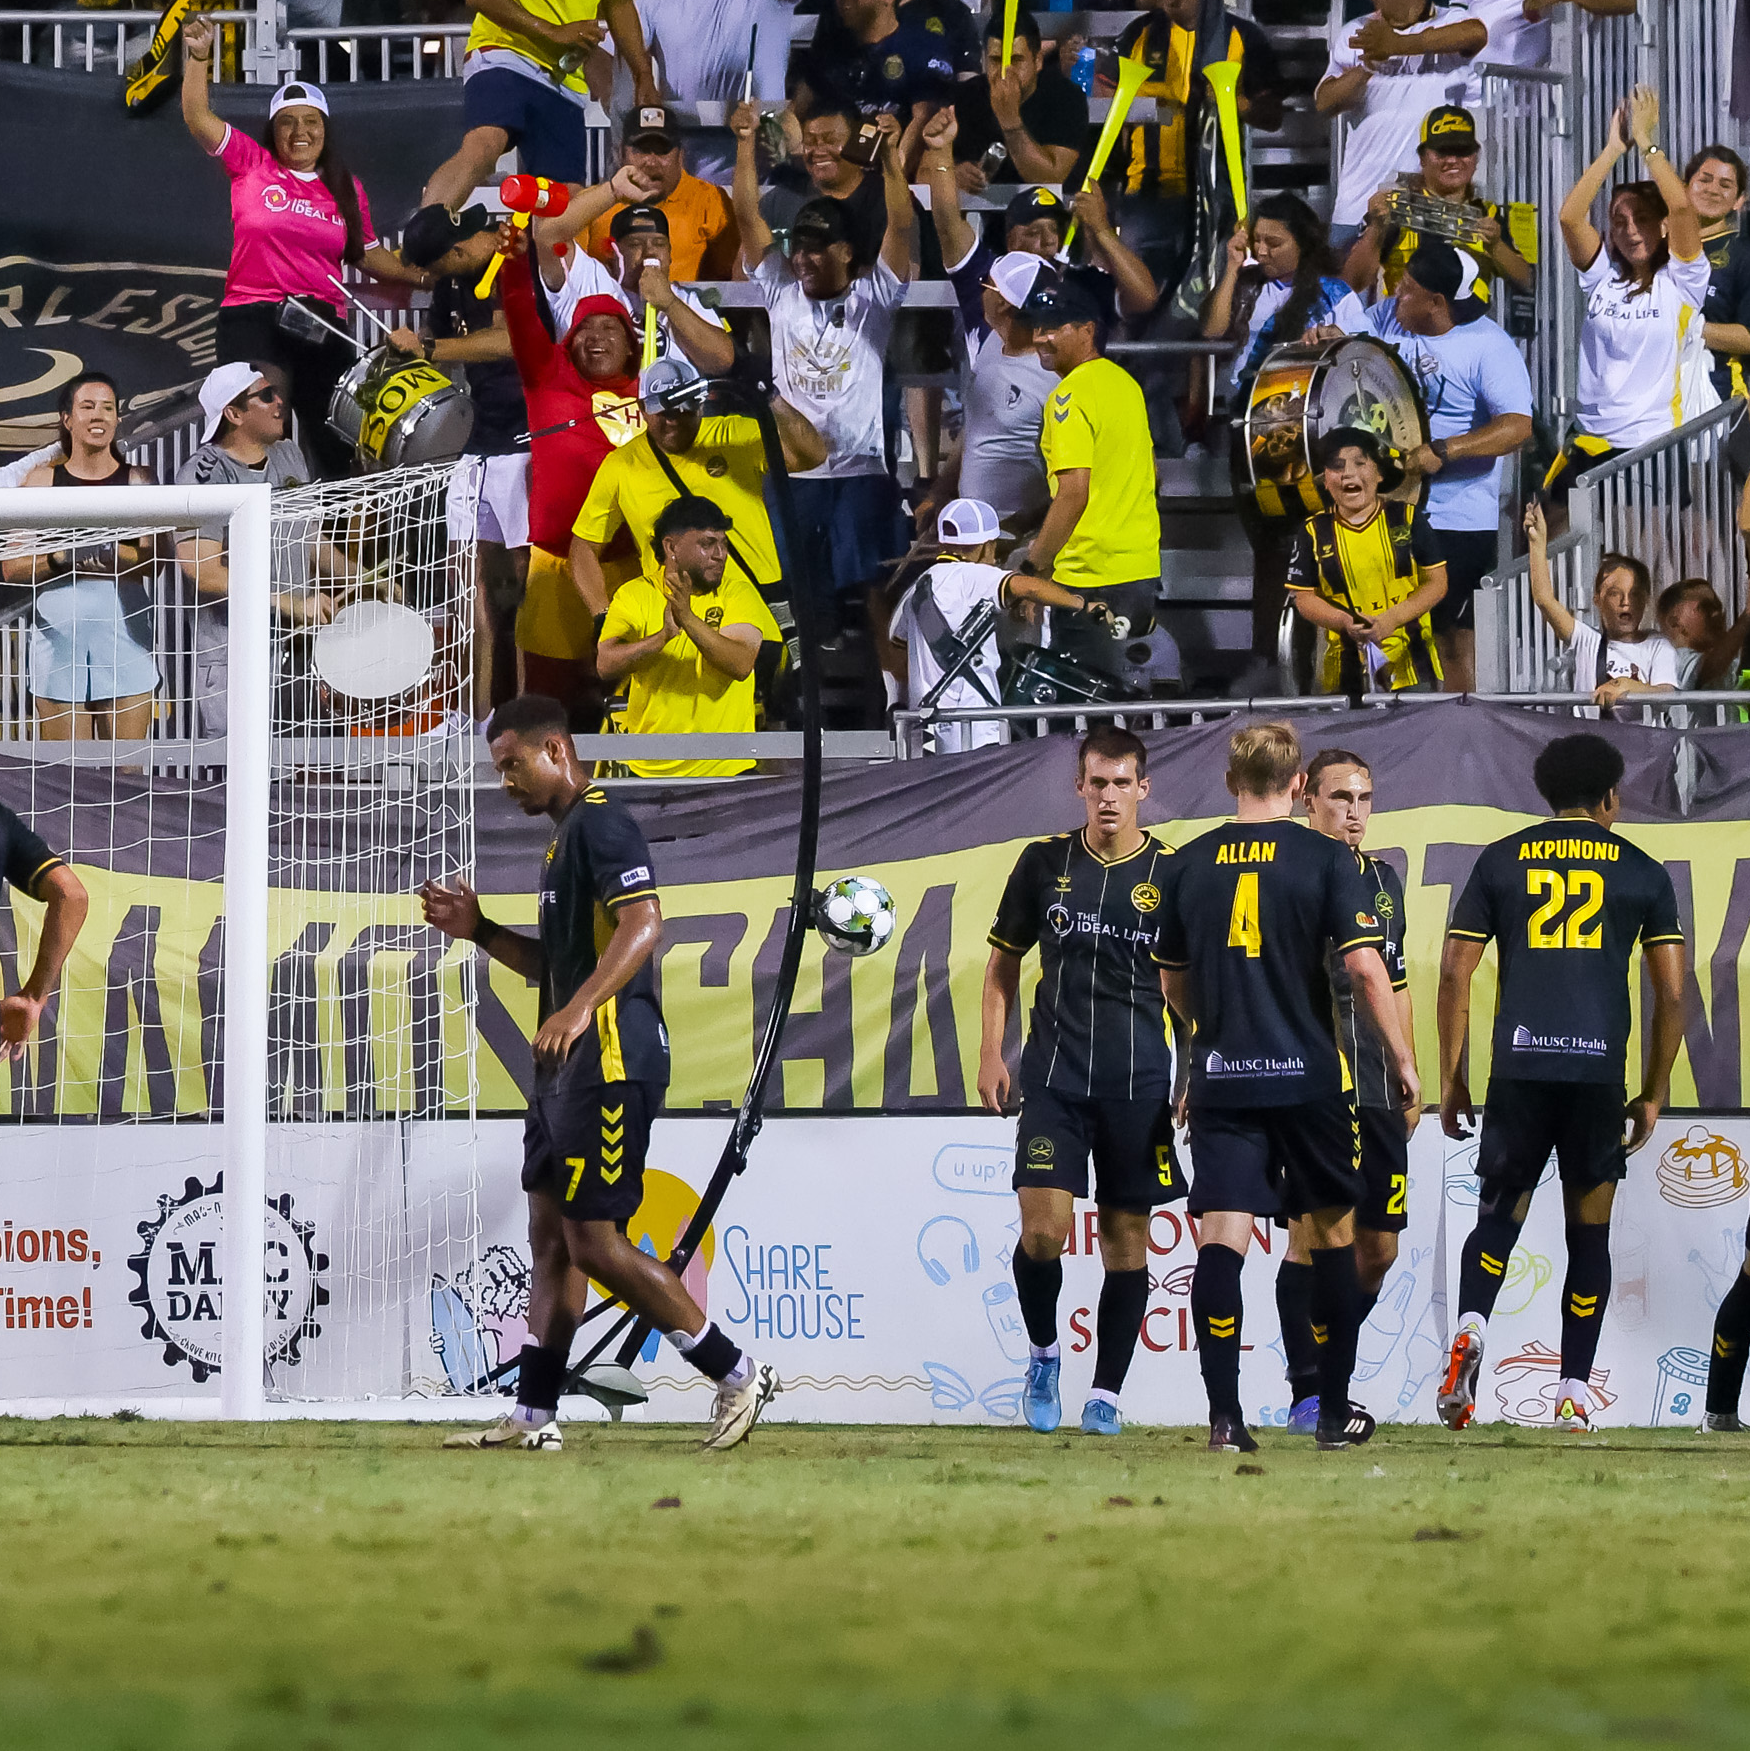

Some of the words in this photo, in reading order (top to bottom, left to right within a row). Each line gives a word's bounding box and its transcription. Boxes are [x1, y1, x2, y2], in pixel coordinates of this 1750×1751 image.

[1215, 842, 1276, 864] ALLAN
[1518, 839, 1620, 862] AKPUNONU
[1077, 912, 1097, 922] THE
[1228, 872, 1262, 957] 4
[1527, 869, 1603, 949] 22
[1077, 923, 1119, 937] IDEAL
[1124, 928, 1153, 944] LIFE
[1531, 1036, 1570, 1047] MUSC
[1572, 1037, 1608, 1051] Health
[1223, 1060, 1262, 1072] MUSC
[1265, 1057, 1305, 1070] Health
[565, 1157, 585, 1201] 7
[972, 1161, 1008, 1183] up?
[1386, 1174, 1407, 1215] 2
[167, 1242, 289, 1286] MC
[723, 1225, 833, 1324] SHARE
[754, 1292, 866, 1340] HOUSE
